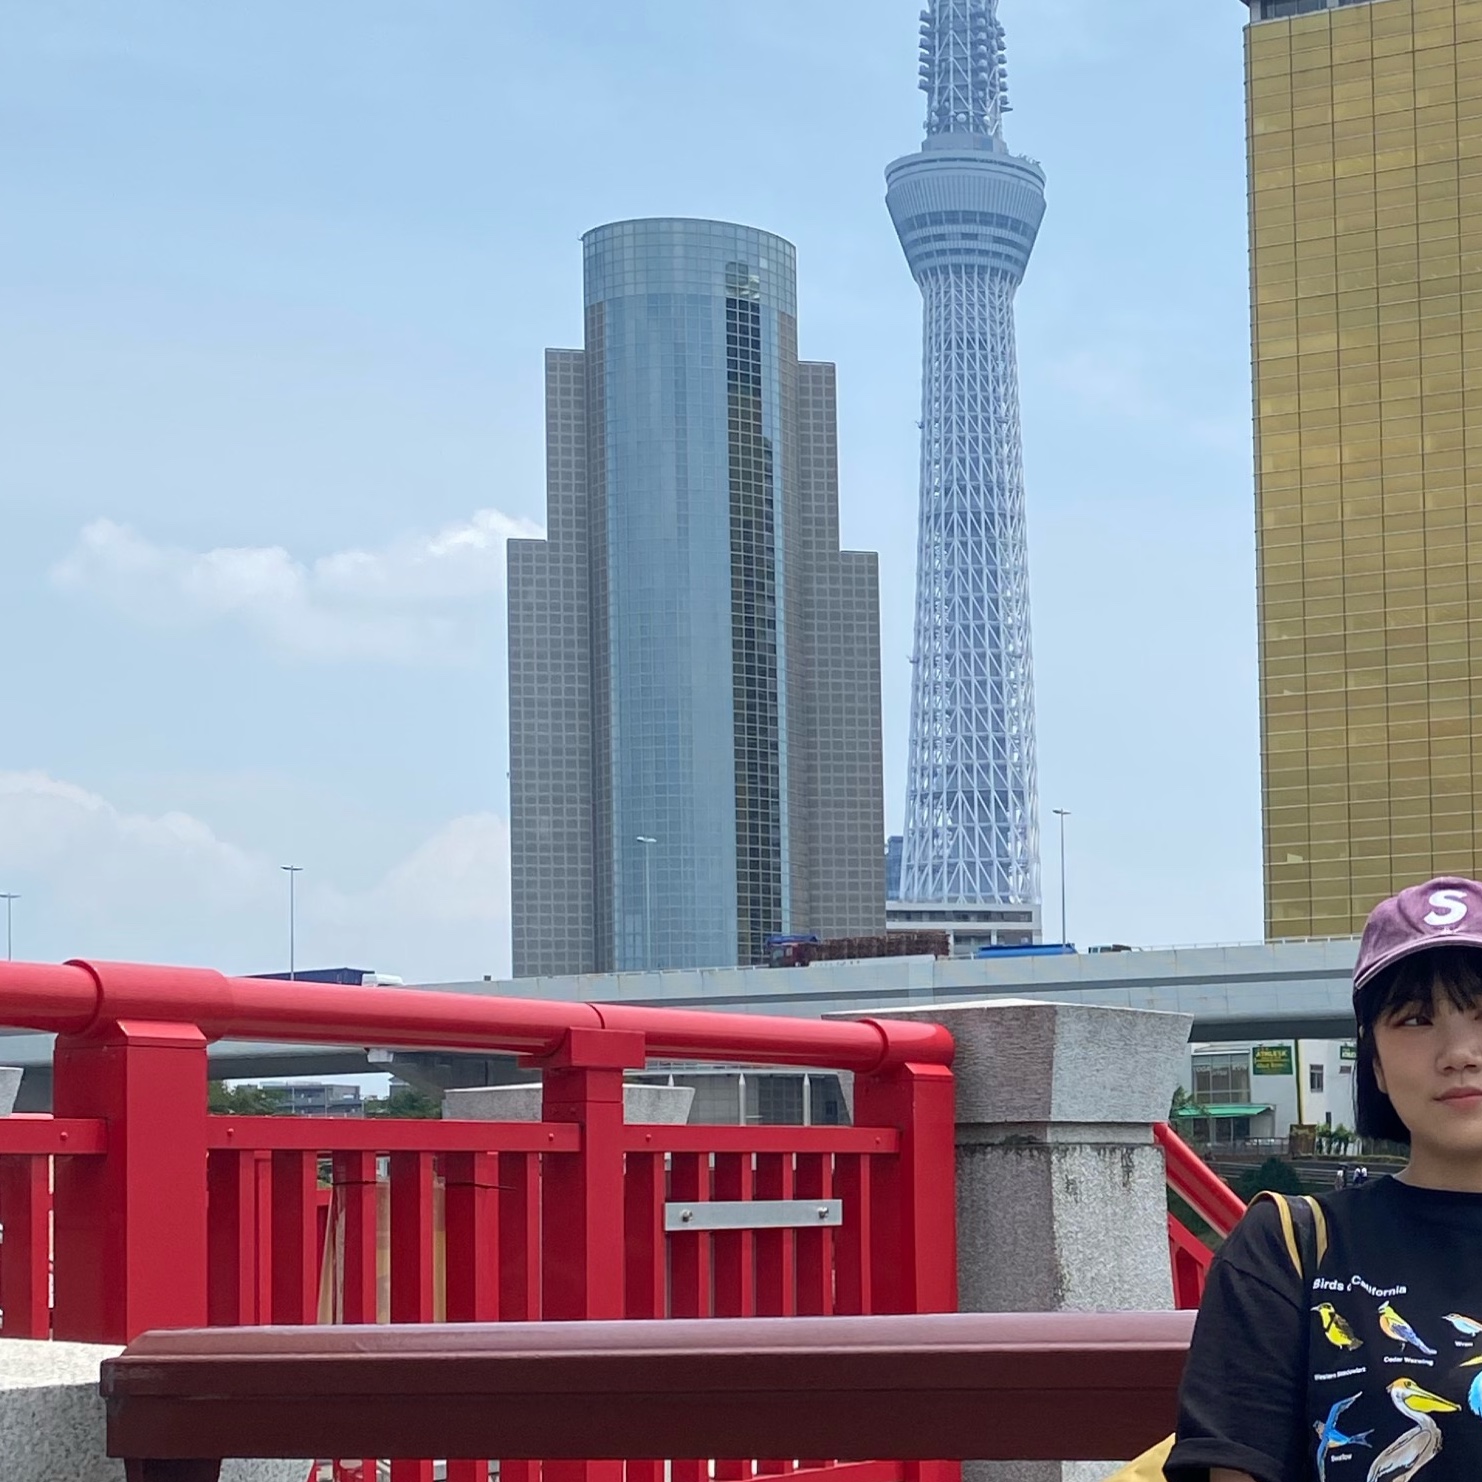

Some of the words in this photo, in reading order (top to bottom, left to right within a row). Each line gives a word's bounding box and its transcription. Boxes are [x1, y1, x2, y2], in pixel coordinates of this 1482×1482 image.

[1423, 889, 1468, 926] S
[1312, 1277, 1345, 1292] Birds
[1350, 1274, 1407, 1297] California
